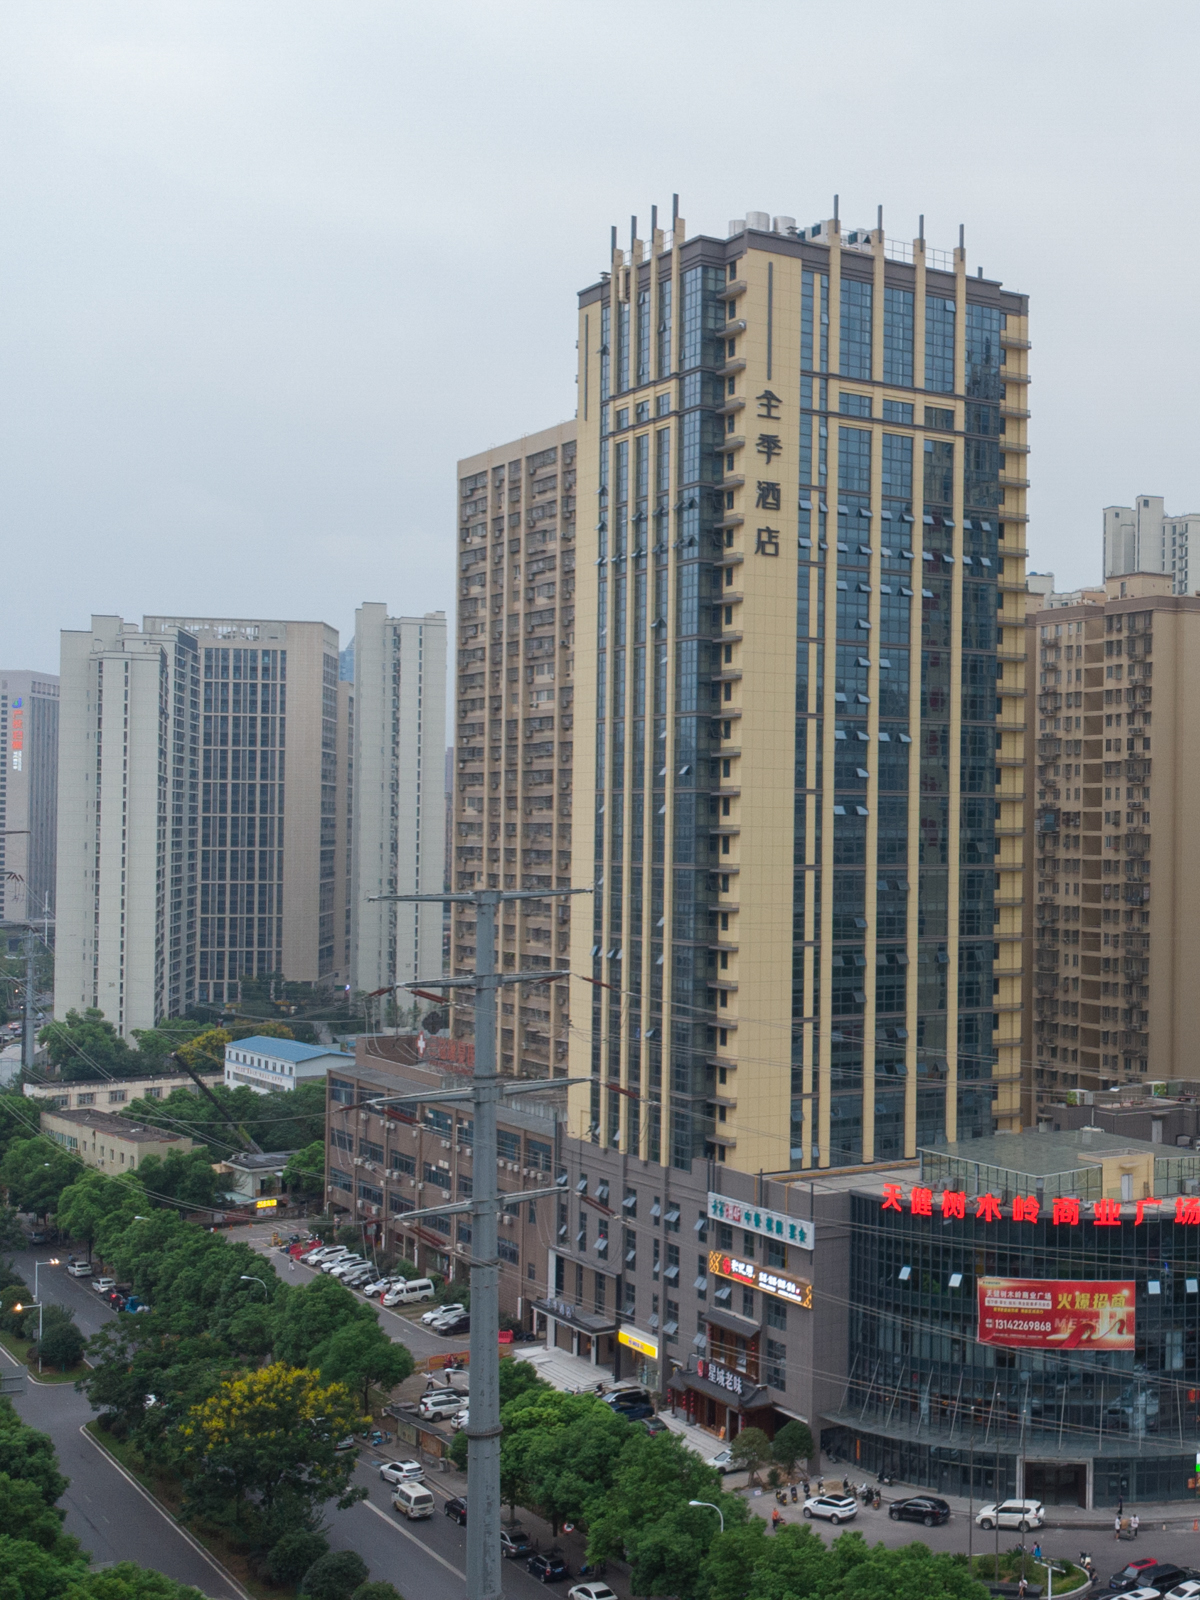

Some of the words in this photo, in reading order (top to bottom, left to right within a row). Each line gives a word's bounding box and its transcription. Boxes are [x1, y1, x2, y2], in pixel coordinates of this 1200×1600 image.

[755, 390, 783, 557] 全季酒店
[881, 1183, 1200, 1226] 天健树木岭商业广场
[987, 1290, 1052, 1300] 天健树木岭商业广场
[1057, 1293, 1126, 1310] 火爆招商
[995, 1319, 1051, 1332] 13142269868
[708, 1363, 743, 1395] 星城老味
